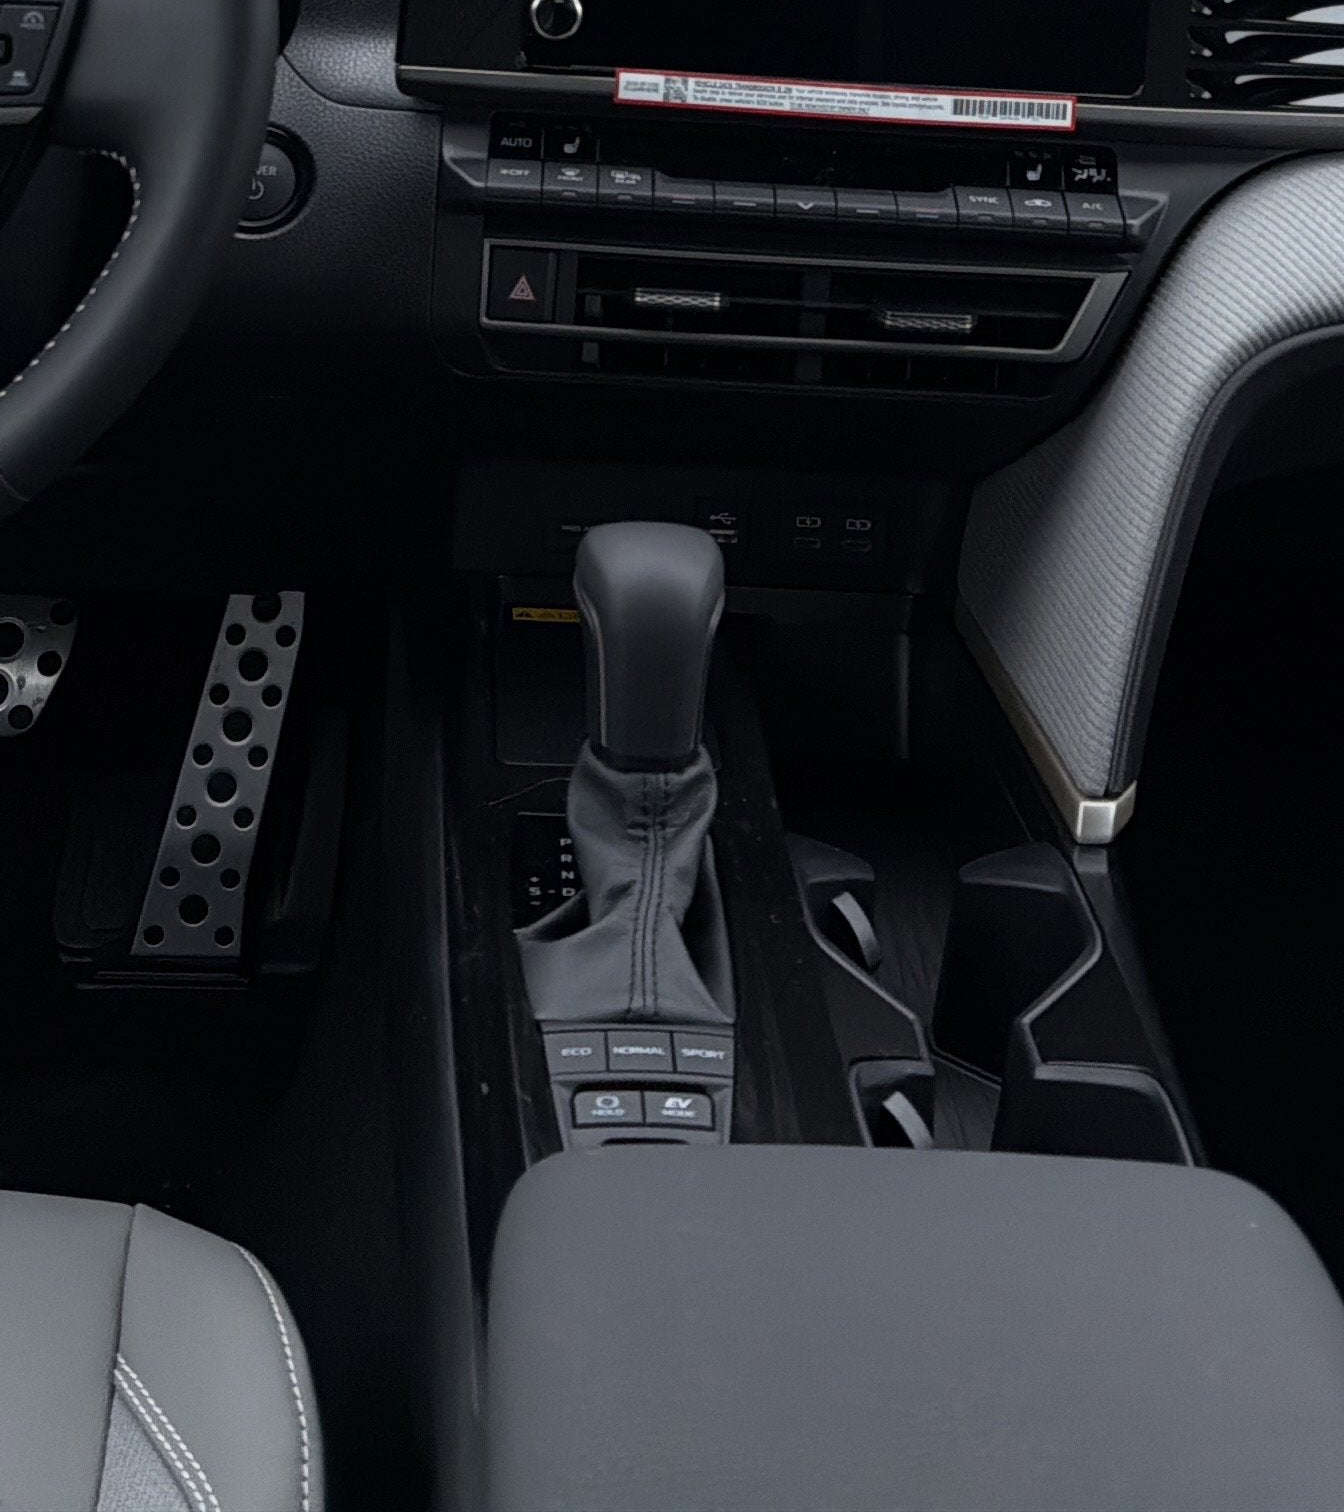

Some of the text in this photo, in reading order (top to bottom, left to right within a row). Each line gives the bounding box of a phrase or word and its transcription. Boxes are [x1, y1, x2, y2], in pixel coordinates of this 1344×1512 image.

[501, 136, 533, 148] AUTO
[968, 195, 1000, 205] SYNC
[1082, 202, 1104, 211] A/C
[560, 837, 573, 847] P
[560, 853, 573, 863] R
[561, 870, 575, 880] N
[528, 886, 576, 897] S D
[561, 1046, 726, 1060] ECO NORMAL SPORT
[664, 1097, 693, 1109] EV
